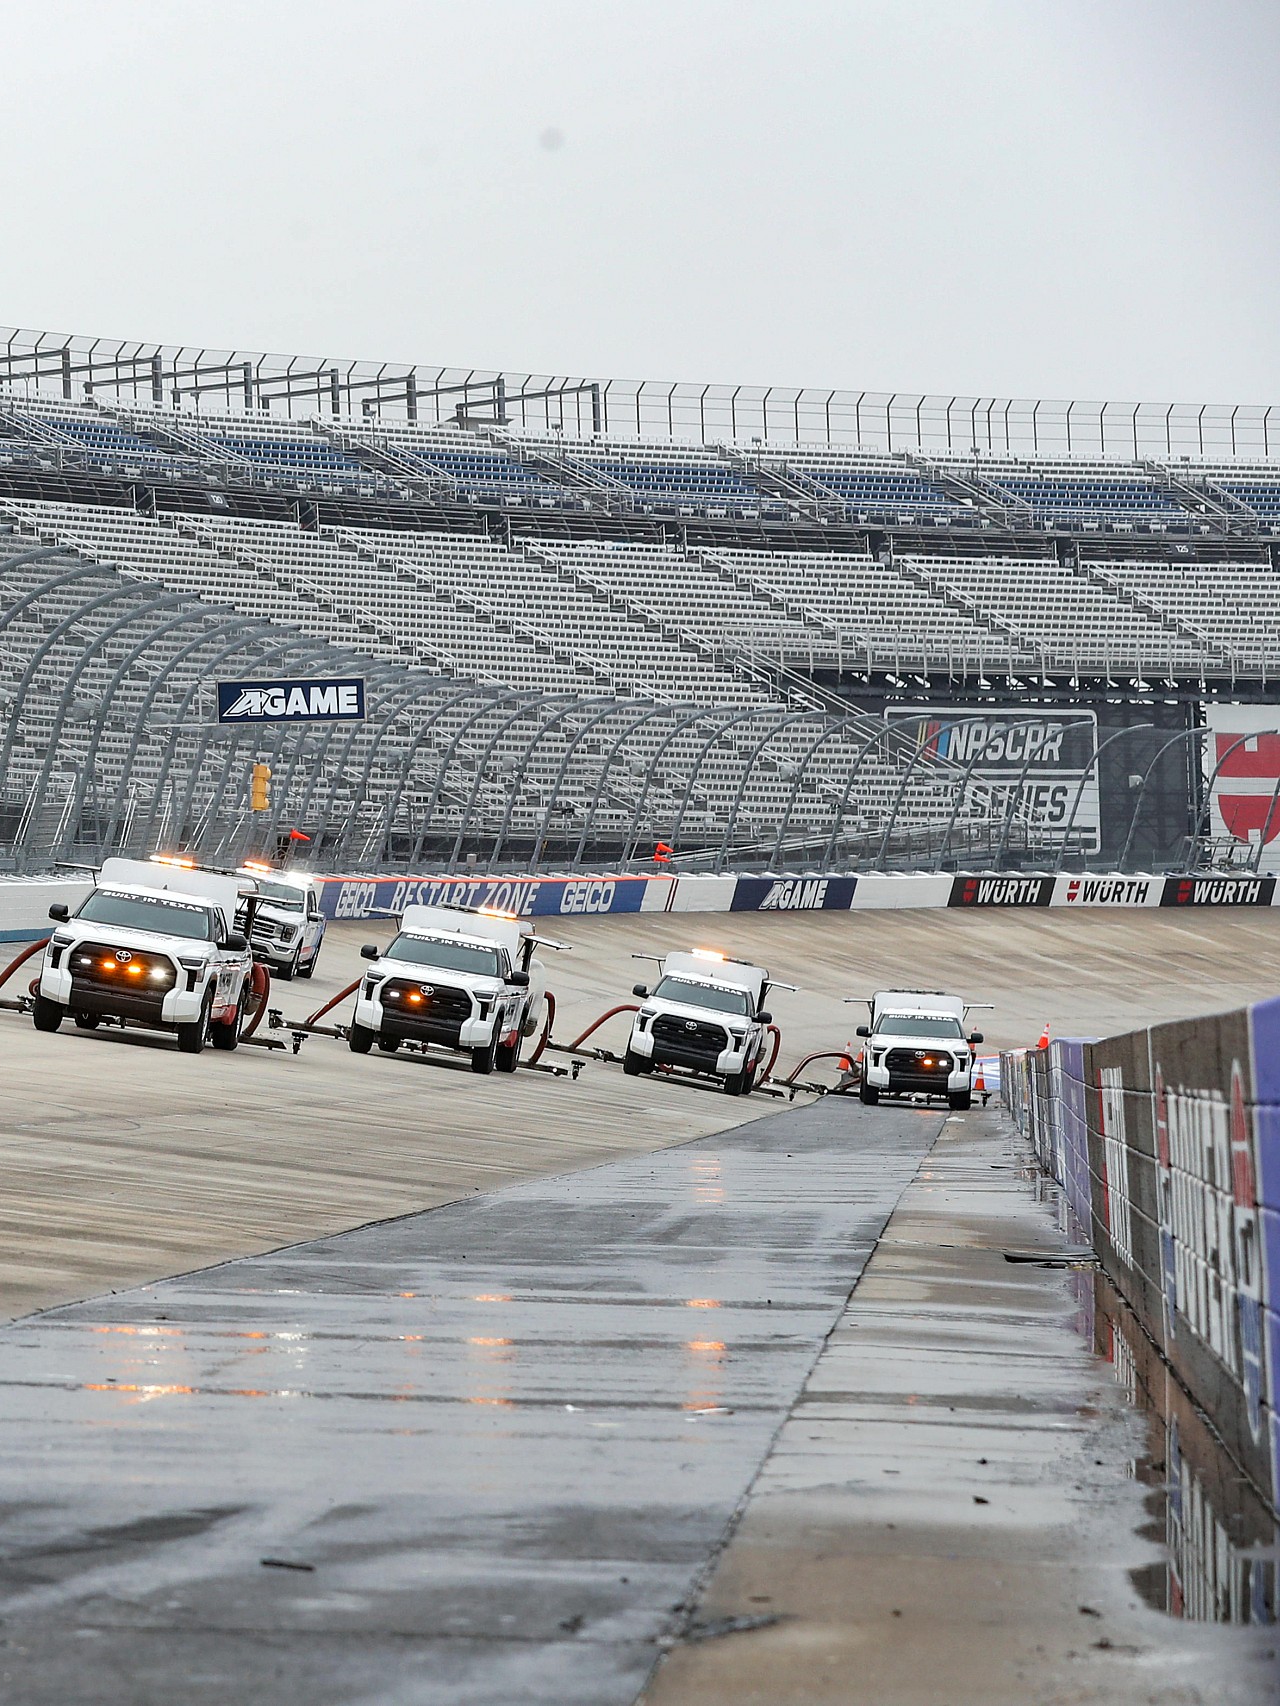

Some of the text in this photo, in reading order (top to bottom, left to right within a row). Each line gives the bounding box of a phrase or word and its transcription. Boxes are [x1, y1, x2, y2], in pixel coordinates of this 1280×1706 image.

[948, 722, 1063, 762] NASCAR
[102, 890, 204, 913] BUILT IN TEXAS
[335, 881, 617, 918] GEICO RESTART ZONE GEICO
[977, 880, 1043, 904] WÜRTH
[1083, 880, 1150, 904] WÜRTH
[1193, 880, 1261, 904] WÜRTH
[406, 934, 493, 953] BUILT IN TEXAS
[671, 977, 697, 985] BUILT
[712, 984, 743, 996] TEXAS
